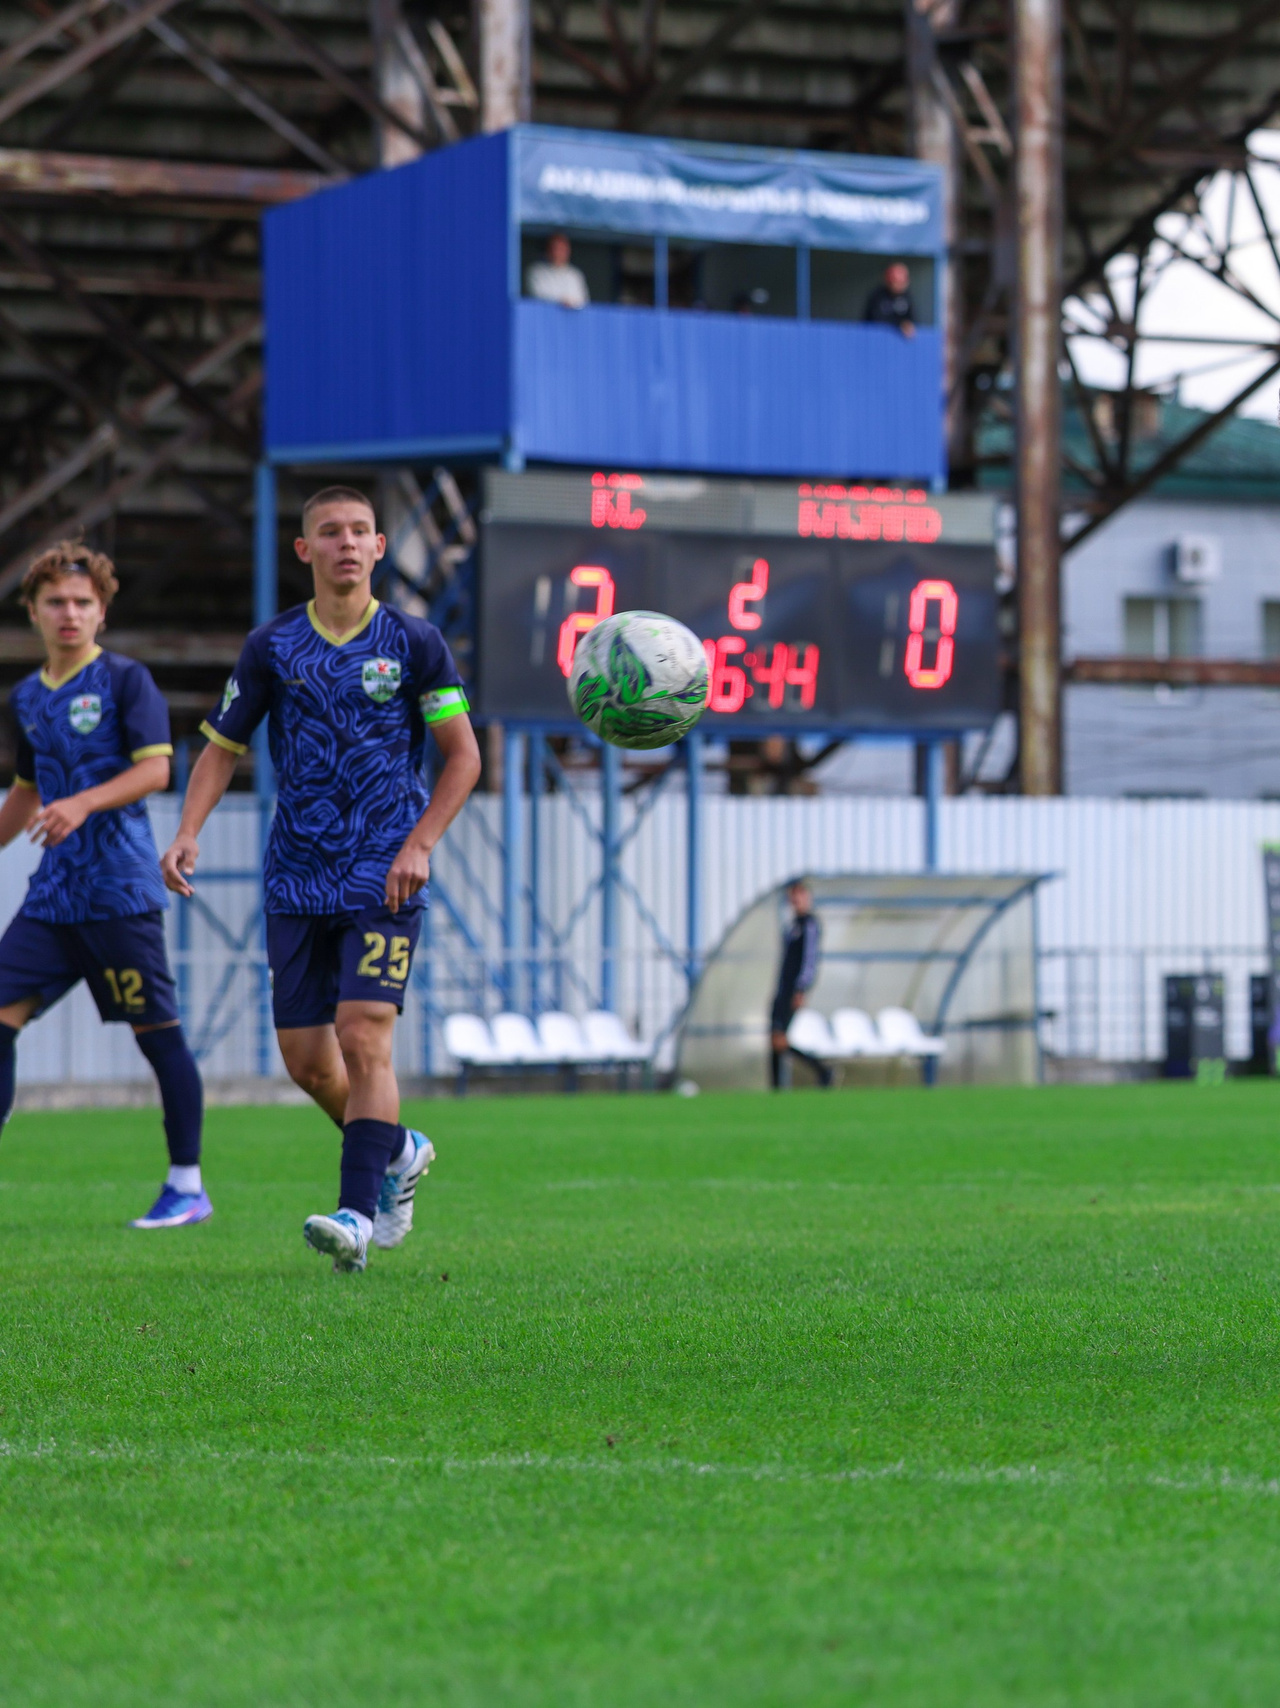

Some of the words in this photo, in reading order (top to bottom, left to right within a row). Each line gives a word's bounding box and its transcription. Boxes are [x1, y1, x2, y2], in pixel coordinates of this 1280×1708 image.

[904, 580, 958, 688] 0
[356, 931, 410, 981] 25
[104, 968, 146, 1006] 12
